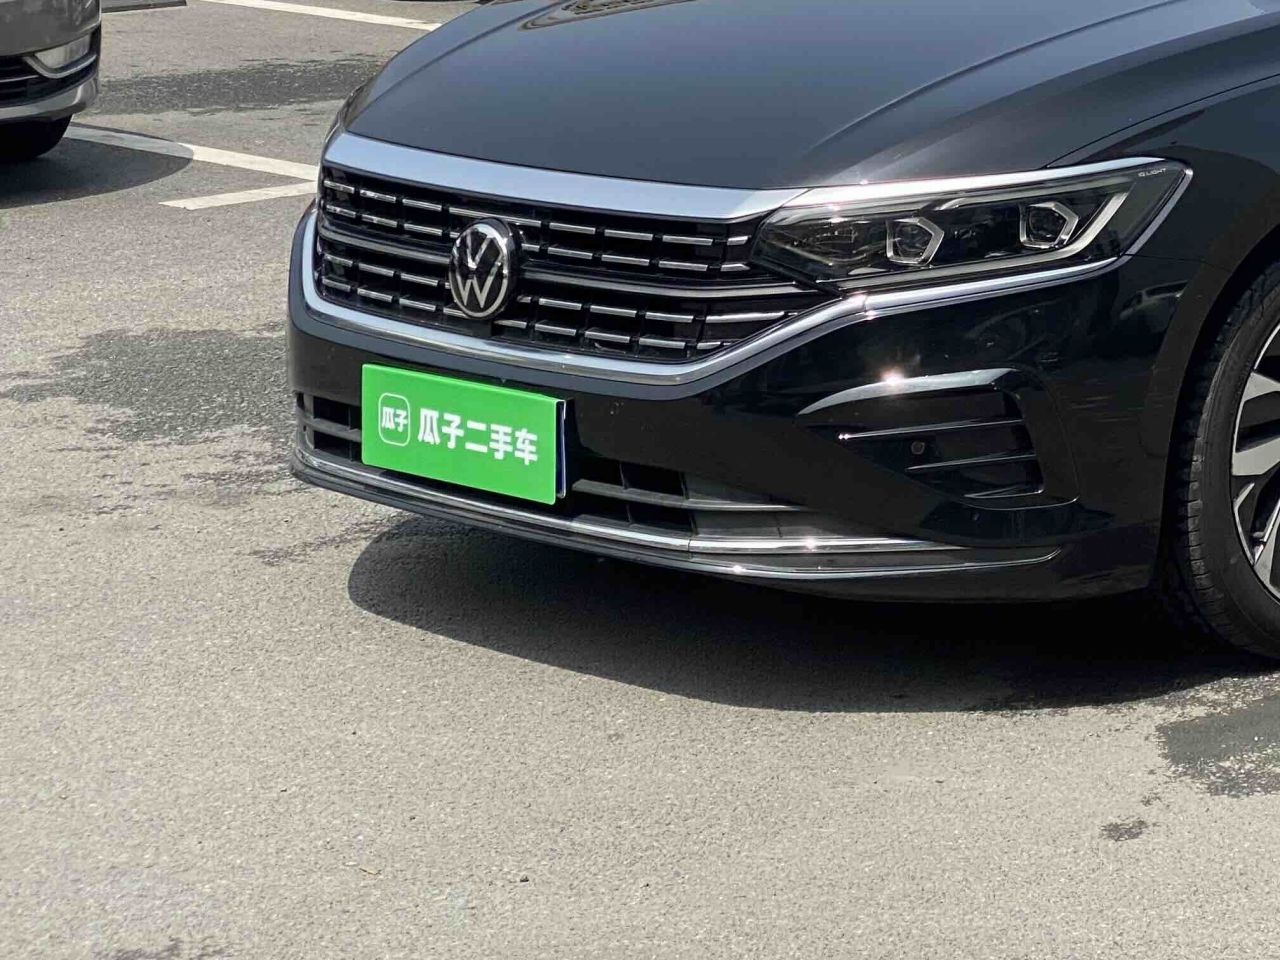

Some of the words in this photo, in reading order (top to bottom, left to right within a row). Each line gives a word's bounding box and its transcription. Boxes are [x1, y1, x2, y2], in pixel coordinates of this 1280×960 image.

[381, 406, 408, 432] 瓜子
[417, 407, 538, 466] 瓜子二手车
